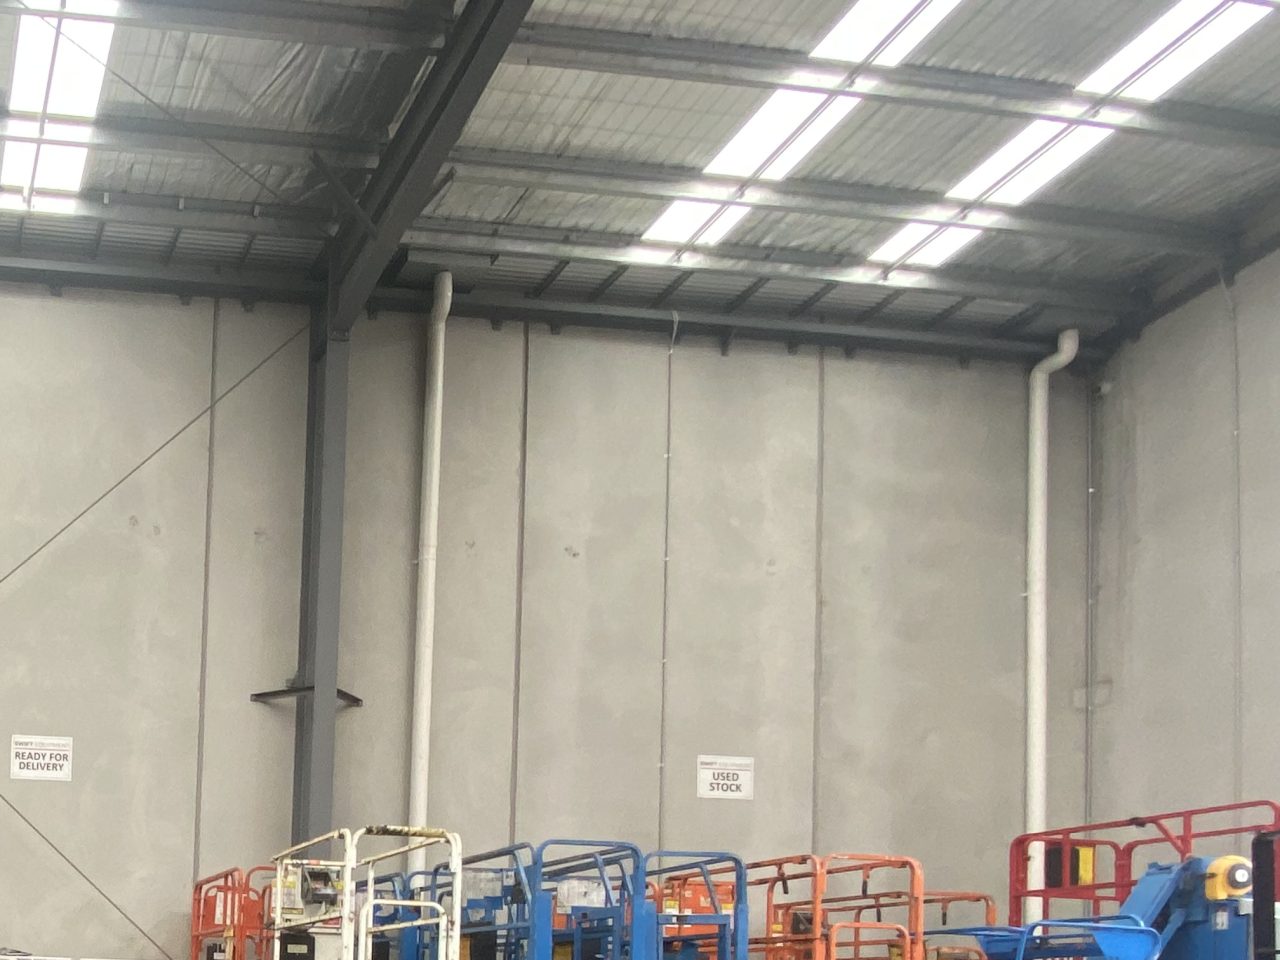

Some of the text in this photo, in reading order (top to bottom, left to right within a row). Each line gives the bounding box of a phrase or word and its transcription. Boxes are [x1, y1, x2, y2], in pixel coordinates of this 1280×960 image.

[15, 751, 69, 762] READY FOR
[18, 761, 64, 772] DELIVERY
[712, 771, 739, 782] USED
[709, 782, 742, 793] STOCK
